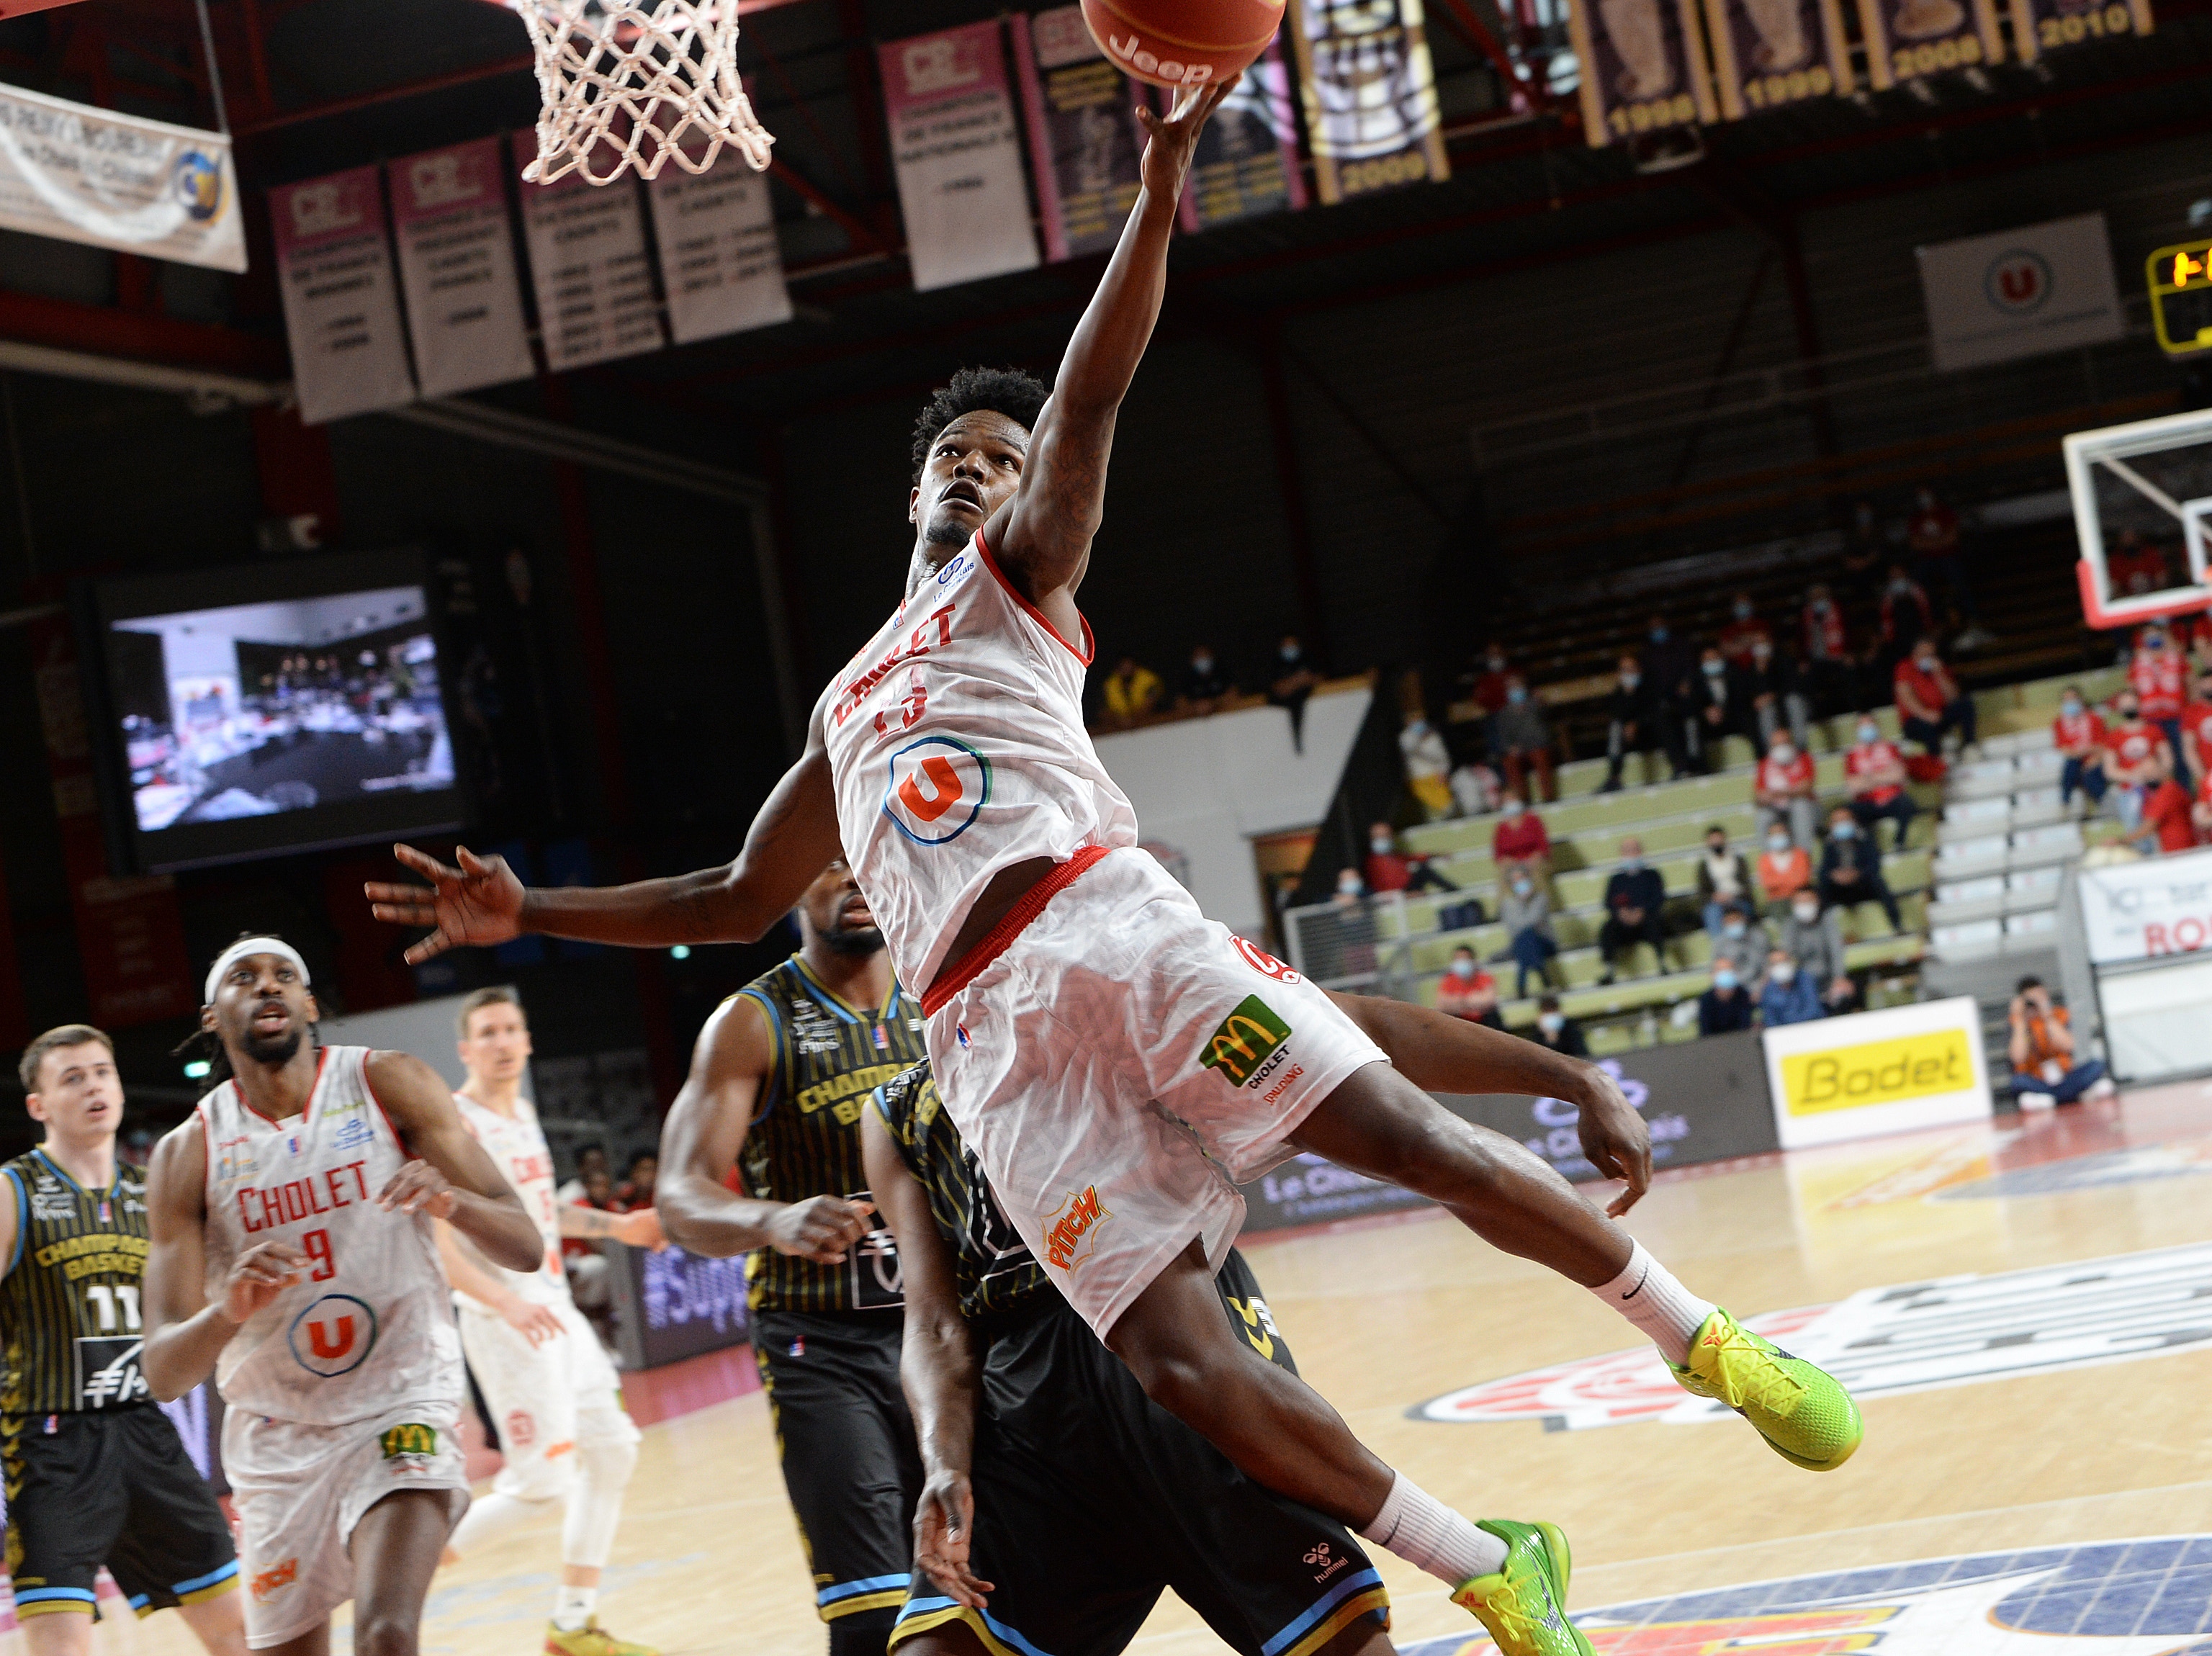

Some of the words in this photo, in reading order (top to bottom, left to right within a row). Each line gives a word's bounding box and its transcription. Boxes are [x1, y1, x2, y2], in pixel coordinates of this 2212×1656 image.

[2040, 4, 2130, 48] 2010
[1109, 34, 1213, 84] Jeep
[1893, 33, 1982, 78] 2008
[1745, 66, 1832, 107] 1999
[1248, 1045, 1291, 1089] CHOLET
[1799, 1047, 1960, 1104] Bodet
[238, 1160, 368, 1233] CHOLET
[302, 1228, 336, 1282] 9
[86, 1284, 142, 1331] 11
[1313, 1556, 1349, 1584] hummel
